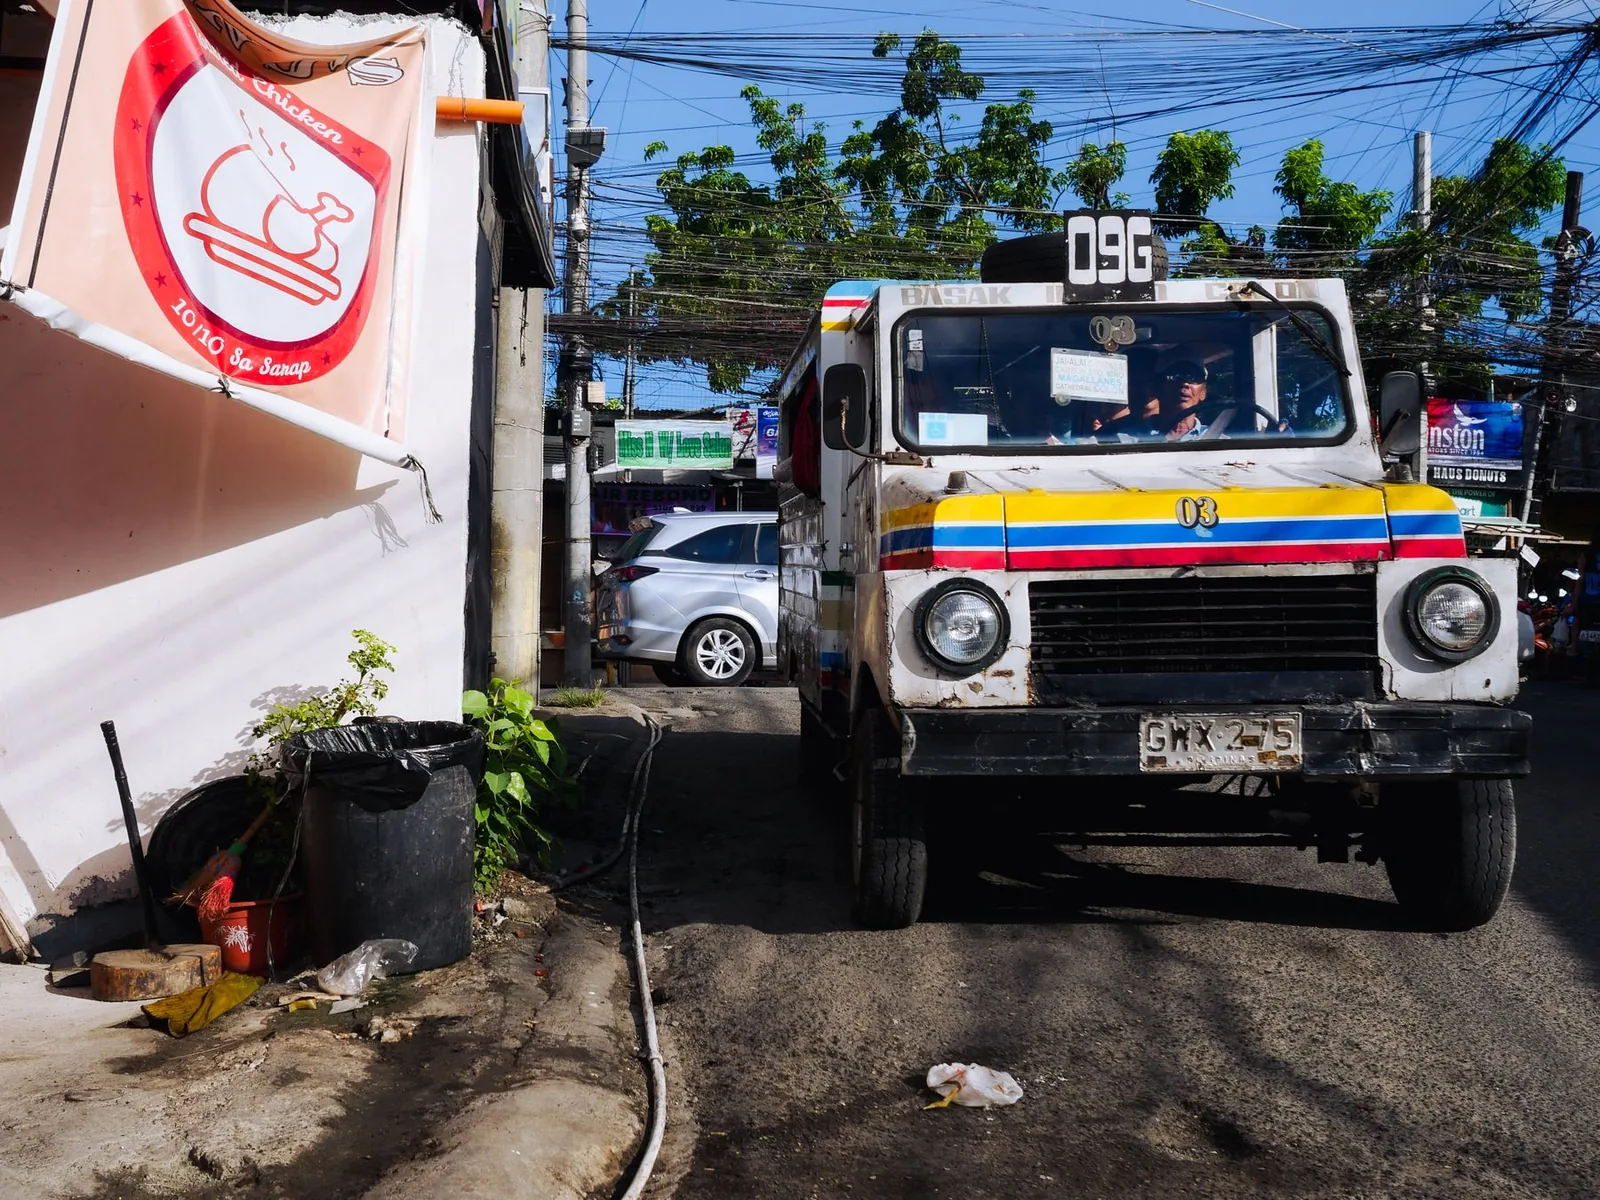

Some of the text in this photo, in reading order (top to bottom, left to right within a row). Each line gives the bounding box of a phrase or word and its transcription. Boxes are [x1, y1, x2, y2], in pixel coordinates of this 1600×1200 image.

[252, 75, 344, 145] Chicken
[1067, 215, 1153, 285] 09G
[900, 286, 1013, 306] BASAK
[170, 297, 312, 381] 10/10 Sa Sarap
[1088, 315, 1137, 345] 03
[1428, 424, 1485, 450] nston
[1433, 466, 1507, 483] HAUS DONUTS
[591, 487, 621, 500] AIR
[1175, 496, 1219, 529] 03
[1459, 506, 1475, 516] art
[1146, 718, 1216, 752] GWX
